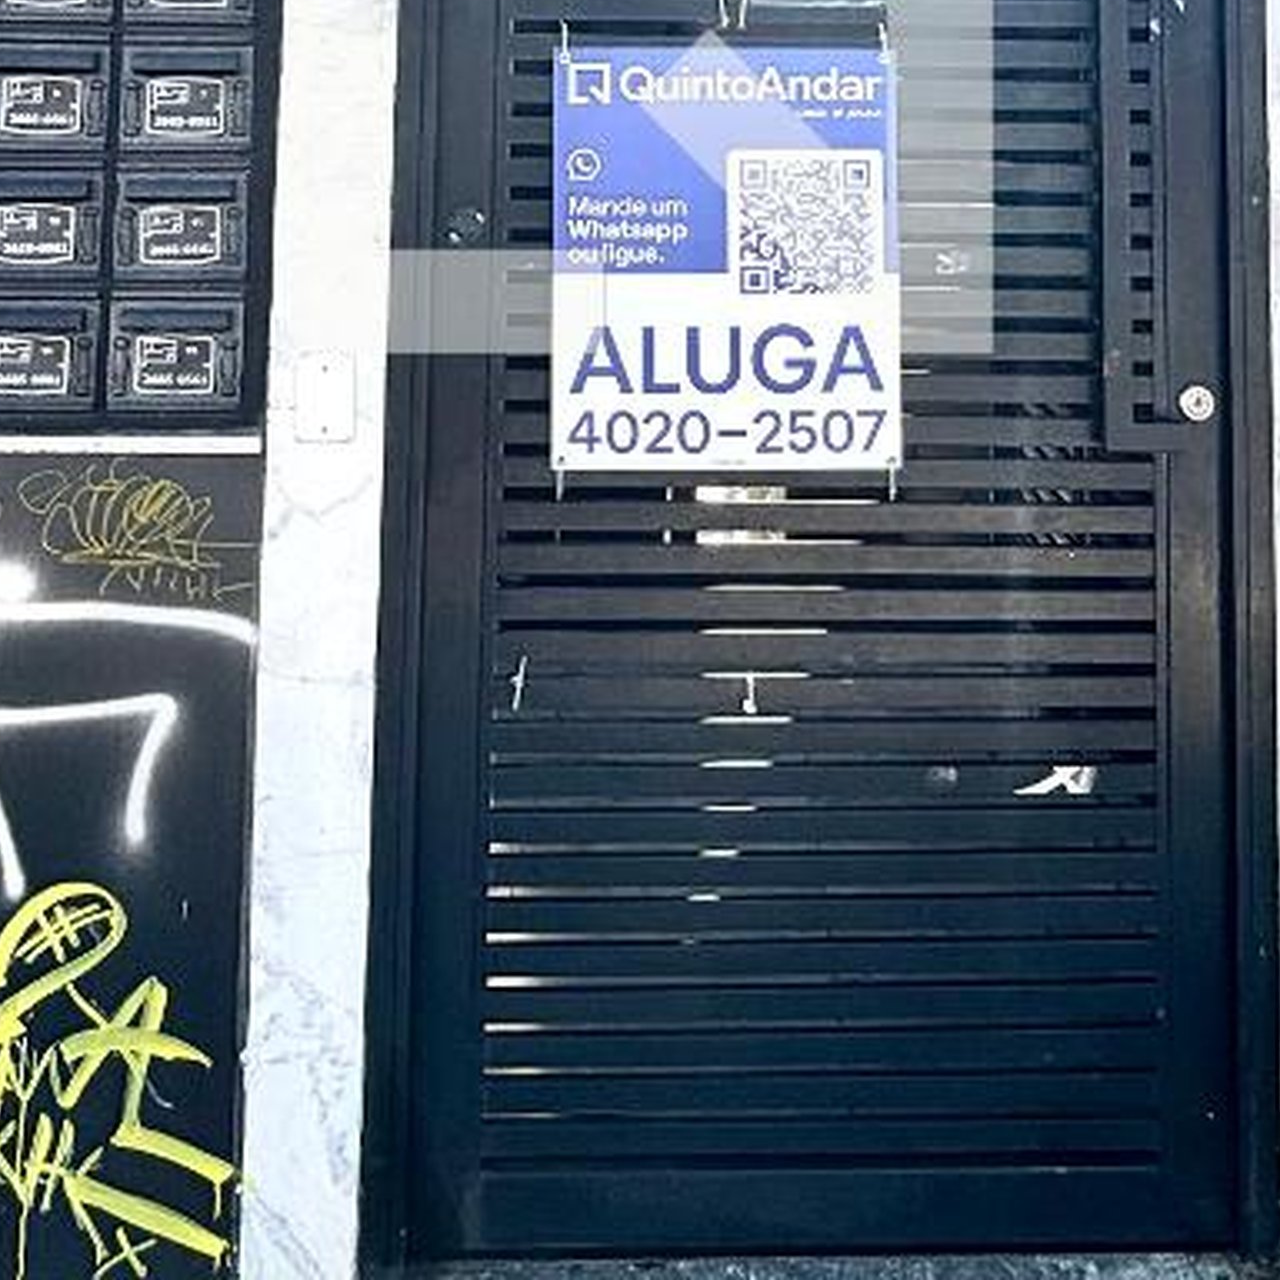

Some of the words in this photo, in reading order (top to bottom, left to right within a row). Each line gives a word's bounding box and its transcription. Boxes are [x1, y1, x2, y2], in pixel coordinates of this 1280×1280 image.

[619, 65, 884, 103] QuintoAndar
[568, 196, 647, 217] Mande
[650, 198, 690, 217] um
[567, 218, 690, 244] Whatsapp
[568, 322, 885, 396] ALUGA
[567, 408, 889, 456] 4020-2507
